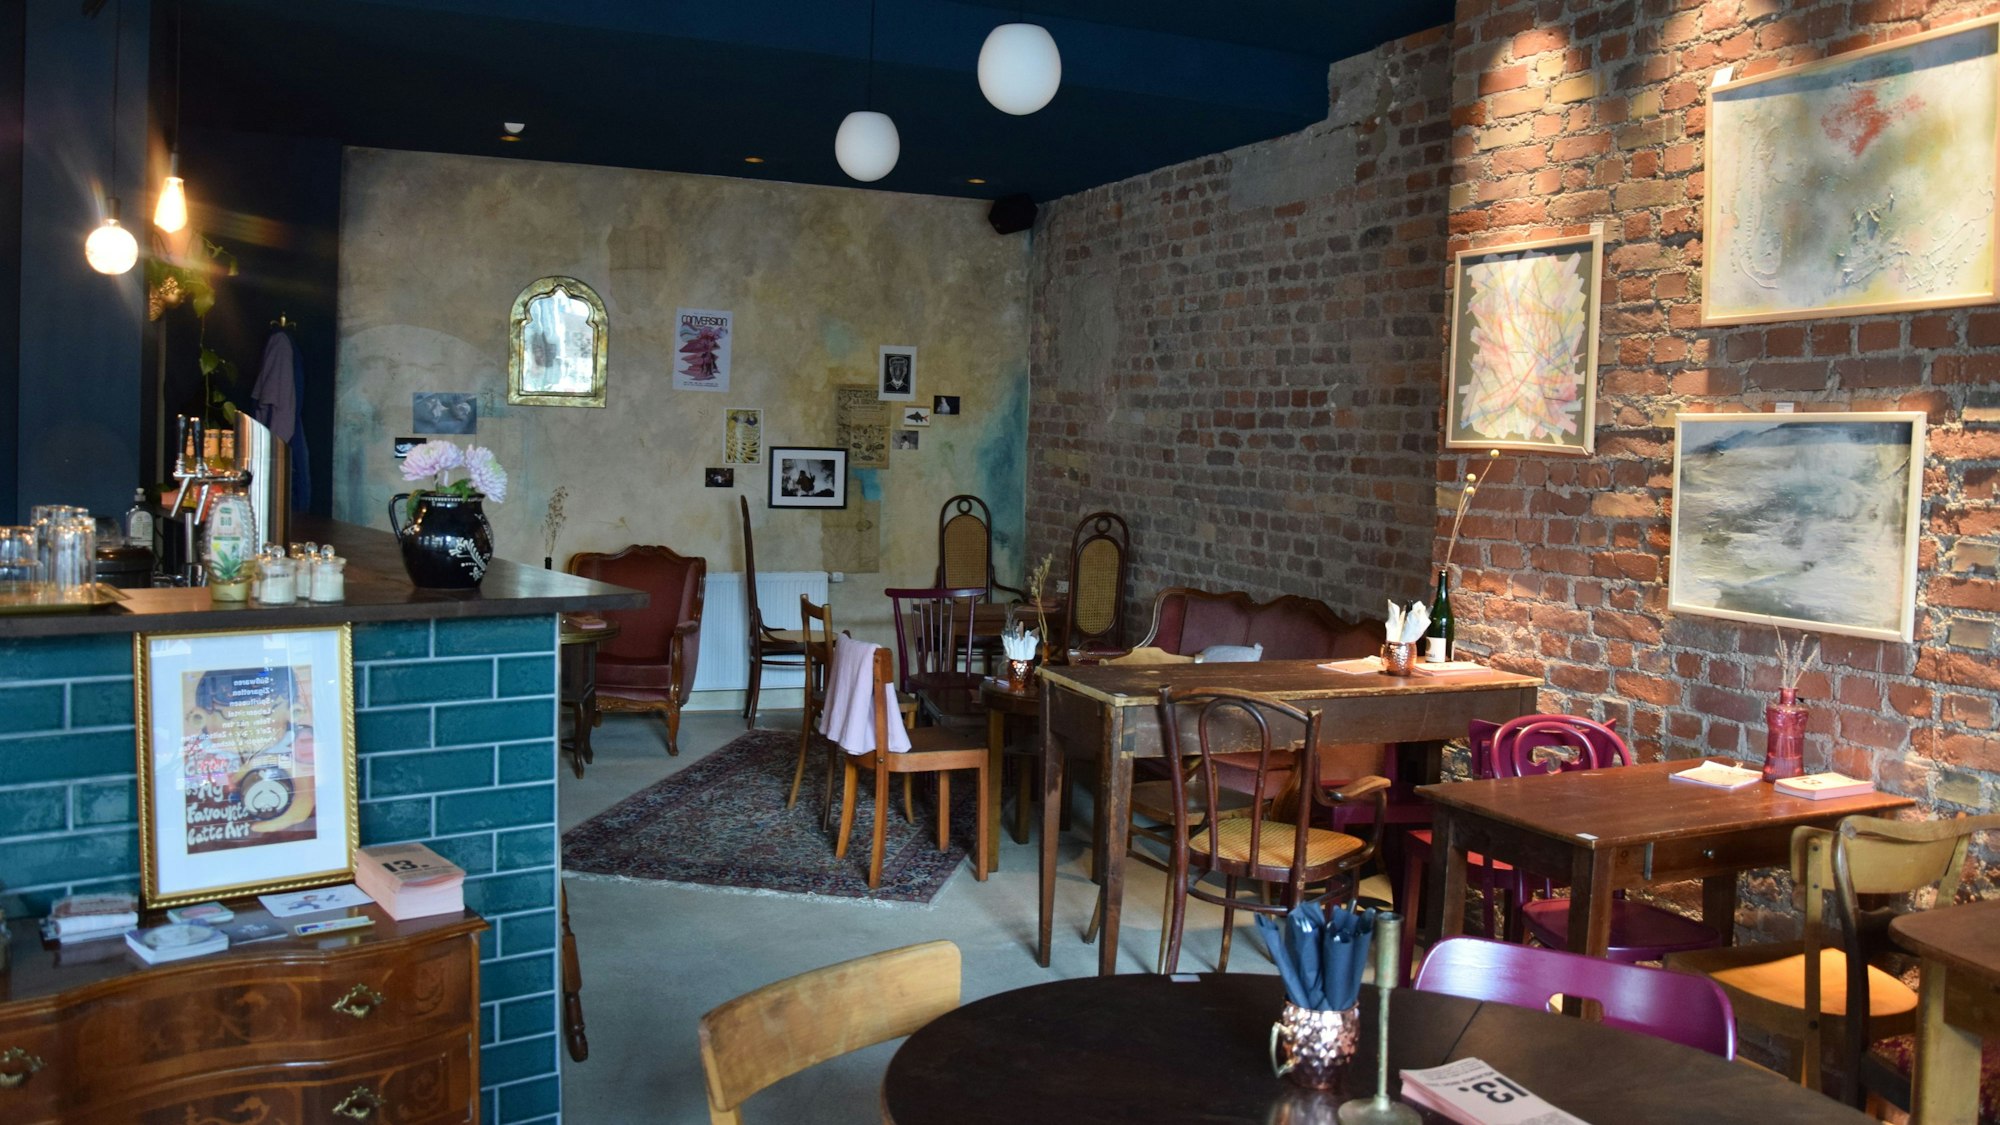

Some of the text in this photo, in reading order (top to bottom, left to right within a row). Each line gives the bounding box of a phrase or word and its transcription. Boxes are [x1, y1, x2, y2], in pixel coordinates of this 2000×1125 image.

[187, 801, 249, 824] Favourite
[225, 821, 250, 839] Art
[381, 859, 431, 873] 13.
[1458, 1077, 1529, 1104] 13.
